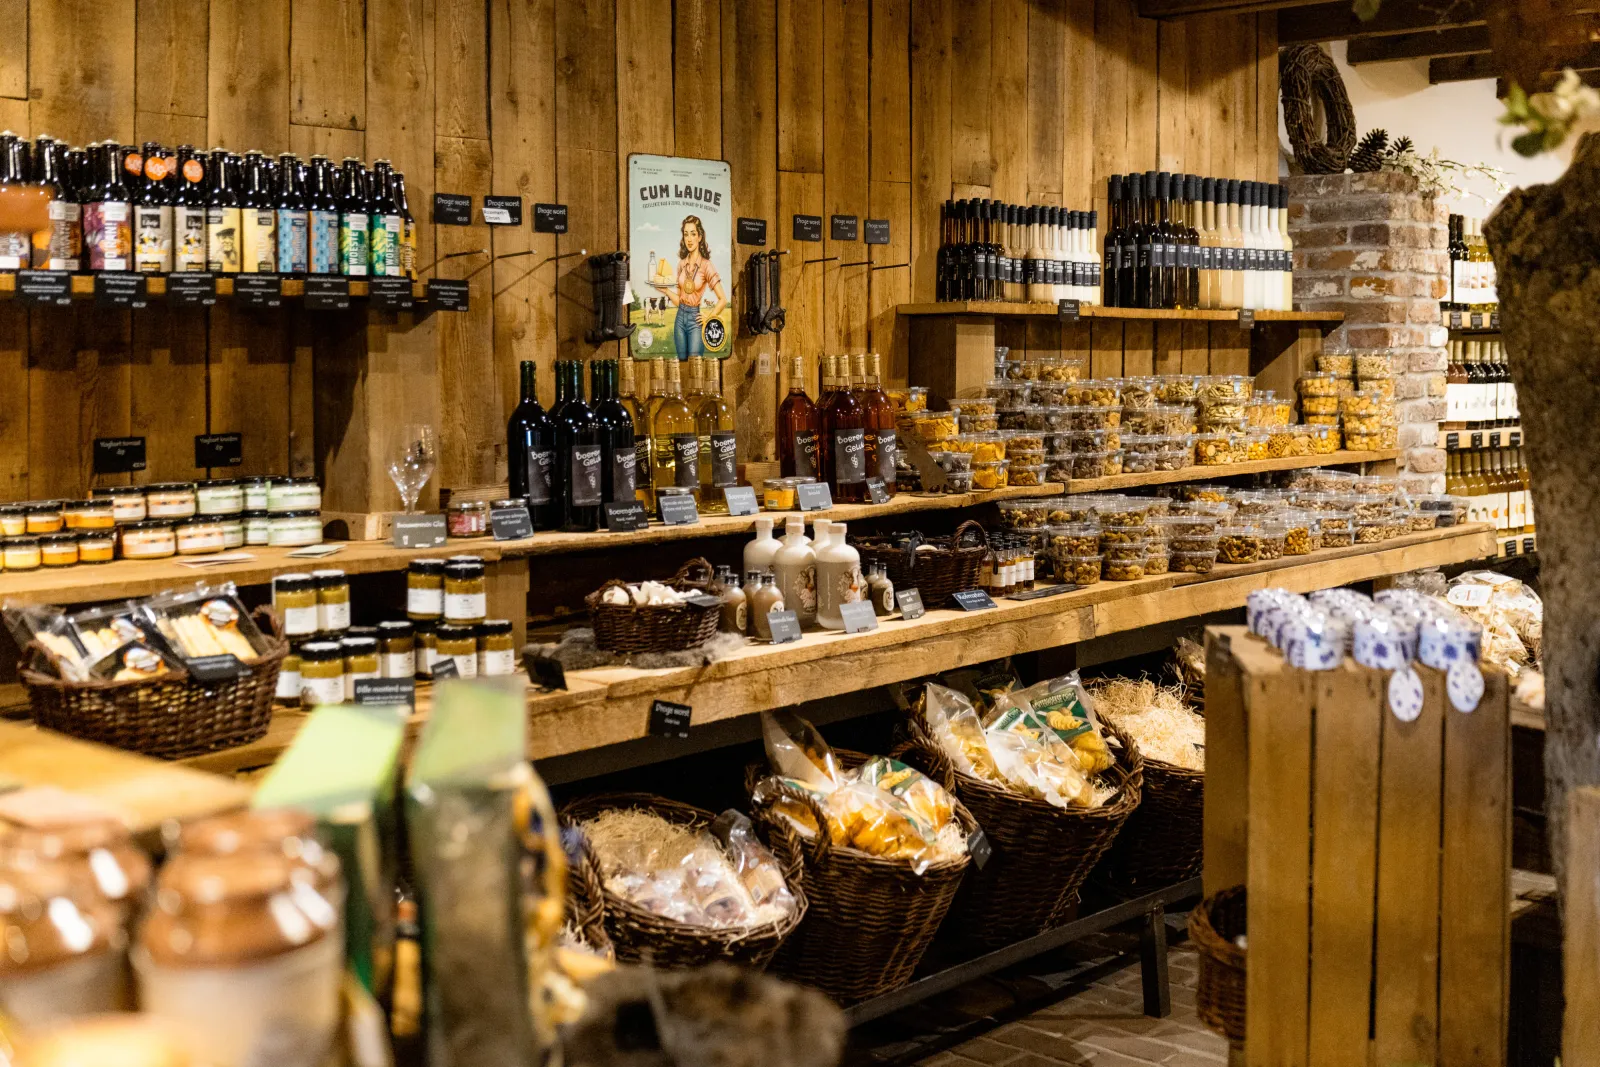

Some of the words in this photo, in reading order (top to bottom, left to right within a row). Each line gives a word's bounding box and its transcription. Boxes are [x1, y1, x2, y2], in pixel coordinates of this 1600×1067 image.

[640, 184, 669, 201] CUM
[674, 184, 722, 206] LAUDE
[437, 197, 455, 207] Droge
[454, 199, 470, 207] worst
[487, 199, 504, 208] Droge
[504, 200, 520, 208] worst
[537, 206, 553, 215] Droge
[552, 207, 566, 215] worst
[797, 217, 809, 225] Droge
[808, 218, 820, 226] worst
[349, 231, 359, 265] WOESTE
[386, 232, 395, 266] WOESTE
[837, 433, 863, 445] Boeren
[845, 443, 865, 453] Geluk
